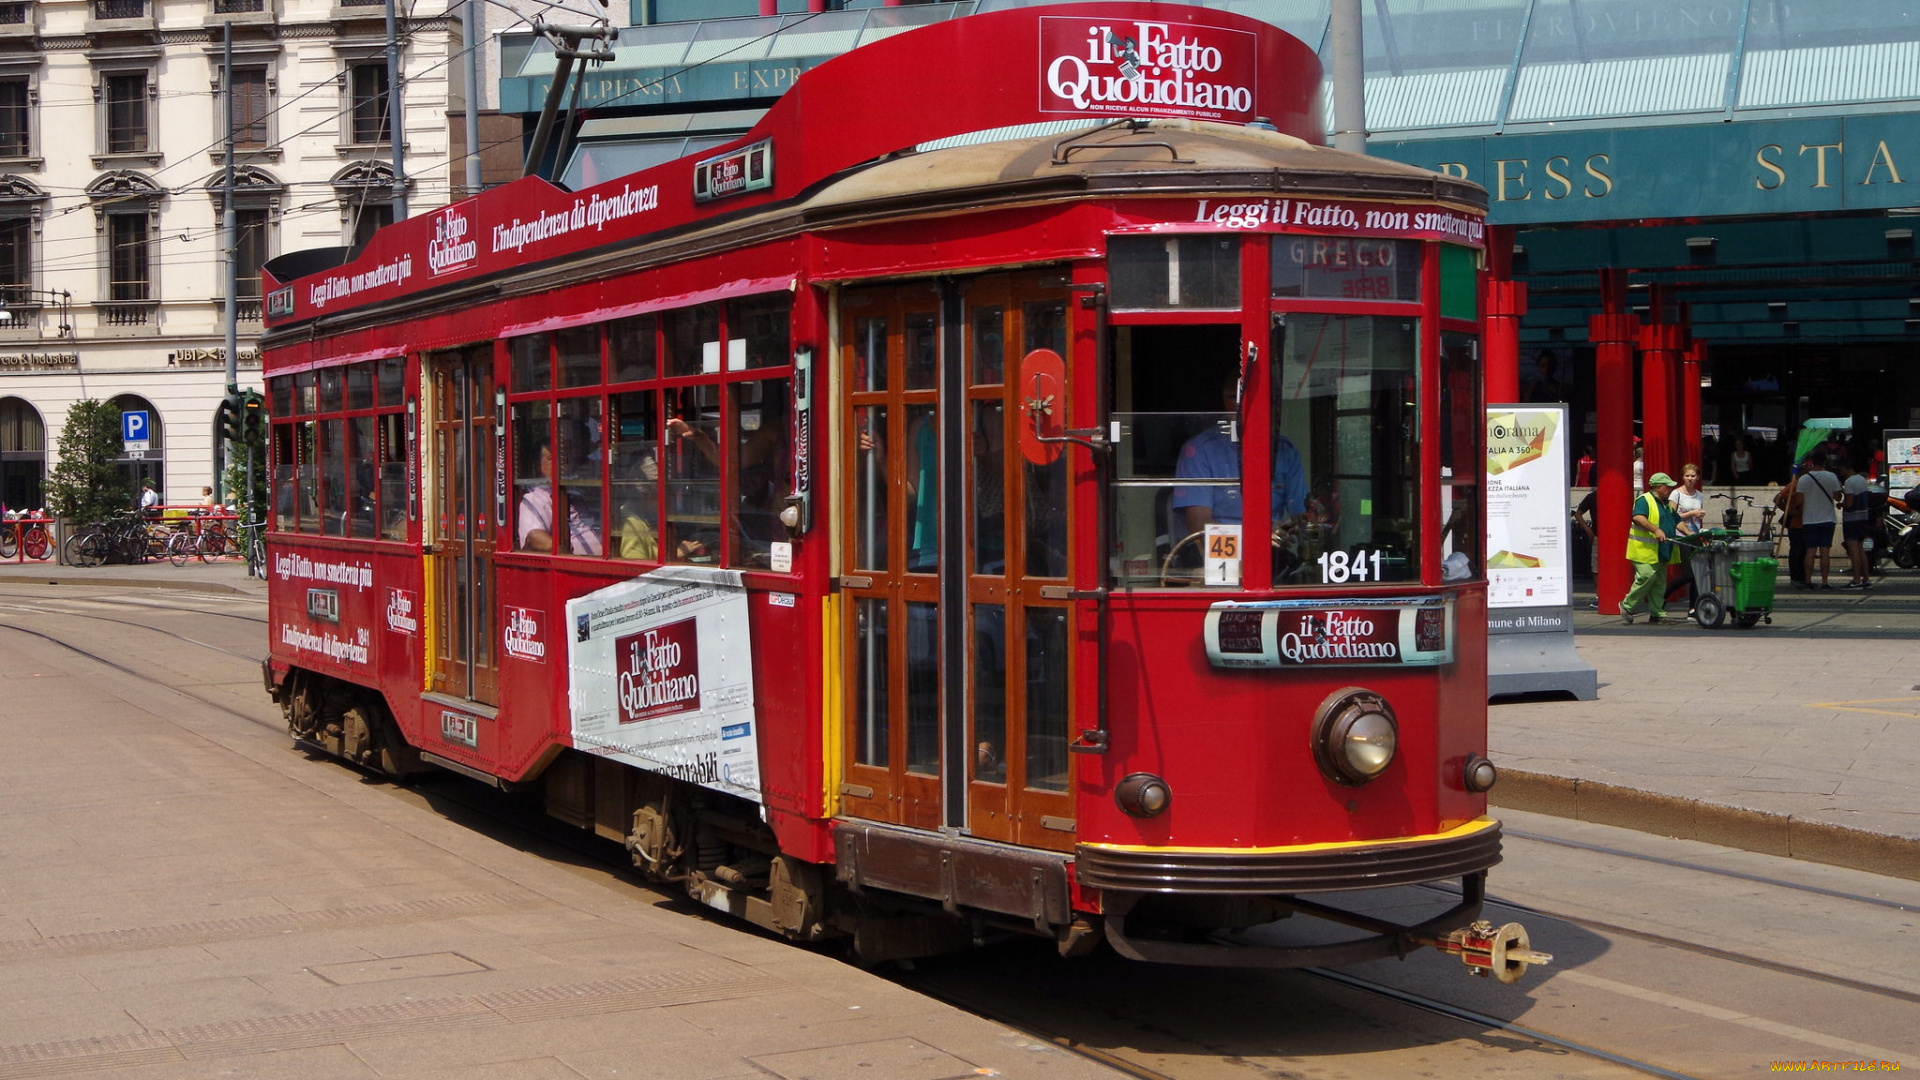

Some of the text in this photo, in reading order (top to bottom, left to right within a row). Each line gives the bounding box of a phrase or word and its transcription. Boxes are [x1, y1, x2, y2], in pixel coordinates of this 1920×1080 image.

[1087, 22, 1222, 73] il Fatto
[734, 66, 813, 90] EXPR
[1047, 55, 1252, 112] Quotidiano
[1150, 107, 1195, 116] FINANZIAMENTO
[1755, 139, 1906, 191] STA
[445, 208, 467, 239] Fatto
[492, 184, 658, 253] L'indipendenza dà dipendenza
[1195, 199, 1483, 242] Leggi il Fatto, non smetterai più
[429, 237, 476, 275] Quotidiano
[1290, 240, 1394, 266] GRECO
[310, 279, 326, 308] Leggi
[351, 274, 364, 293] non
[364, 256, 398, 289] smetterai
[398, 253, 412, 286] più
[20, 354, 28, 364] &
[31, 353, 77, 364] Industria
[175, 349, 196, 360] UBI
[128, 415, 143, 437] P
[1211, 536, 1236, 557] 45
[275, 552, 290, 580] Leggi
[314, 562, 326, 580] non
[359, 562, 372, 592] più
[1218, 561, 1226, 581] 1
[1317, 549, 1381, 584] 1841
[1301, 611, 1374, 637] il Fatto
[1515, 617, 1525, 627] di
[1528, 615, 1561, 627] Milano
[631, 630, 681, 677] il Fatto
[1280, 632, 1397, 663] Quotidiano
[619, 669, 697, 720] Quotidiano
